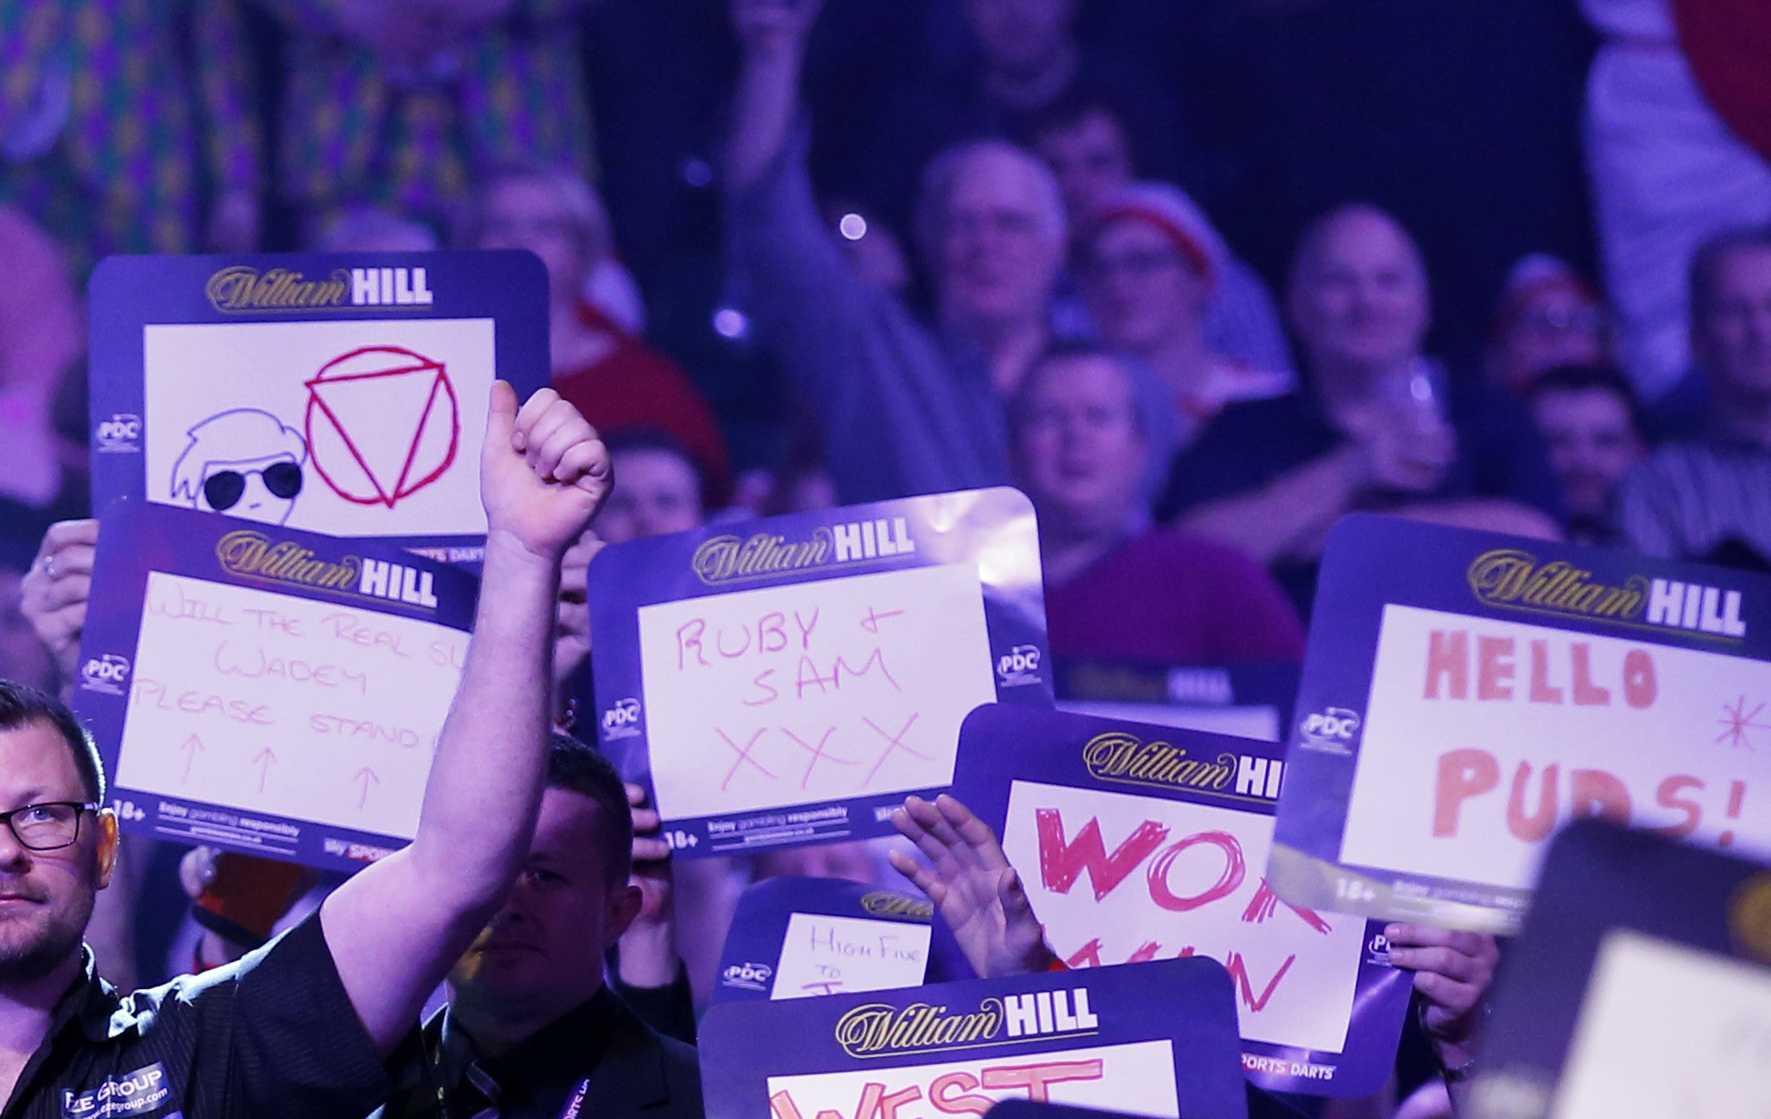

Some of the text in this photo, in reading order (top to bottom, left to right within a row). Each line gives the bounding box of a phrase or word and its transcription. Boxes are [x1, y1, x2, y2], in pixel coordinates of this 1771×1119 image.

[206, 267, 433, 311] William HILL
[99, 416, 139, 441] PDC
[216, 530, 437, 608] William HILL
[693, 518, 916, 585] William HILL
[148, 583, 233, 625] WILL
[243, 608, 304, 637] THE
[321, 612, 410, 658] REAL
[1467, 549, 1747, 637] William HILL
[676, 606, 820, 671] RUBY
[998, 650, 1040, 674] PDC
[1423, 629, 1659, 710] HELLO
[744, 647, 903, 706] SAM
[131, 678, 420, 749] PLEASE STAND
[1083, 732, 1282, 799] William HI
[837, 987, 1098, 1056] William HILL
[96, 1069, 163, 1102] GROUP
[1241, 1053, 1337, 1081] PORTS DARTS
